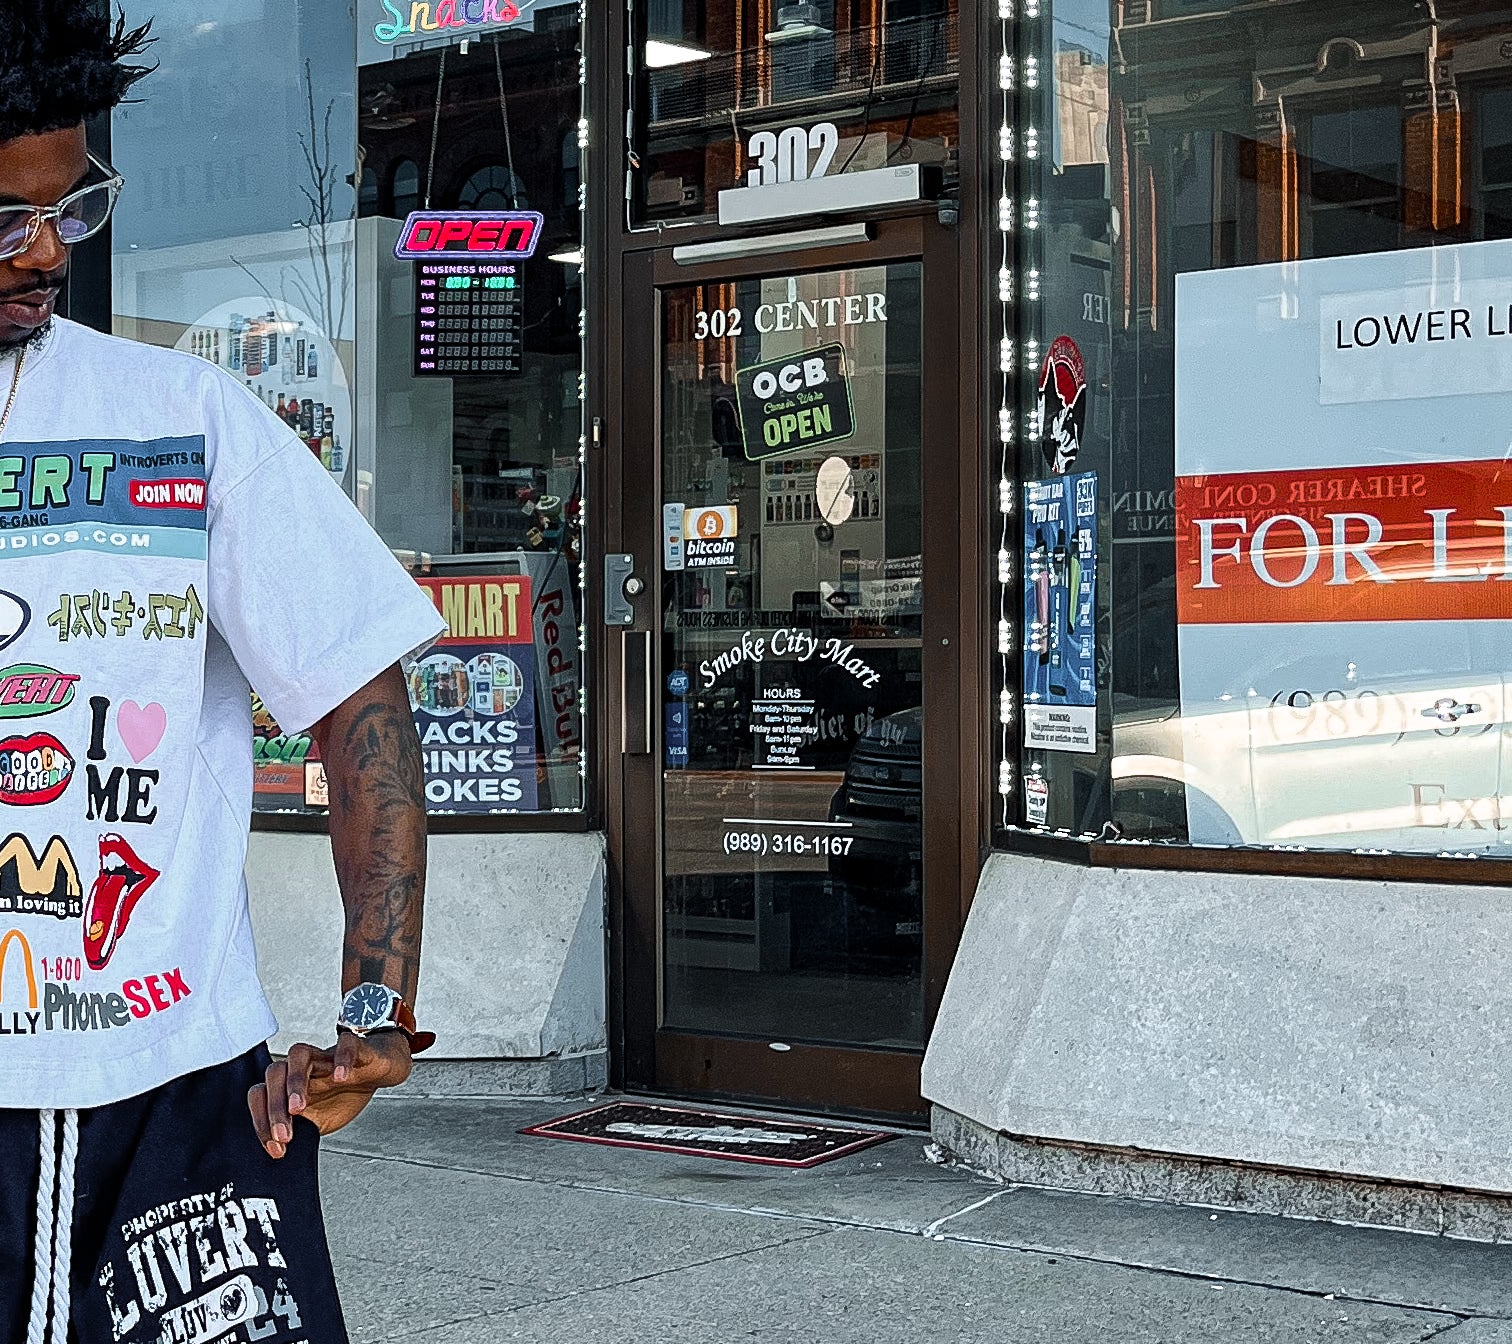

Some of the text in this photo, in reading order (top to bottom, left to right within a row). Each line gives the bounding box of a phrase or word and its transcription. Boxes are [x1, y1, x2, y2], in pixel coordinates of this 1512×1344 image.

[748, 123, 840, 188] 302
[405, 220, 535, 251] OPEN
[422, 265, 516, 275] BUSINESS HOURS
[693, 292, 888, 341] 302 CENTER
[1335, 309, 1471, 350] LOWER
[752, 357, 827, 400] OCB
[763, 403, 833, 447] OPEN
[119, 451, 188, 469] INTROVERTS
[136, 482, 205, 505] JOIN NOW
[686, 538, 735, 556] bitcoin
[687, 557, 707, 567] ATM
[1192, 508, 1512, 590] FOR L
[441, 582, 520, 638] MART
[538, 588, 573, 677] Red
[698, 627, 882, 691] Smoke City Mart
[763, 688, 802, 699] HOURS
[87, 696, 111, 761] I
[416, 720, 519, 745] ACKS
[0, 752, 53, 772] GOOD
[668, 746, 688, 755] VISA
[86, 764, 160, 825] ME
[424, 778, 523, 802] OKES
[723, 831, 854, 857] (989) 316-1167
[16, 895, 66, 916] loving
[68, 901, 82, 915] it
[41, 956, 82, 981] 1-800
[122, 967, 193, 1020] SEX
[98, 1196, 288, 1342] LUVERT
